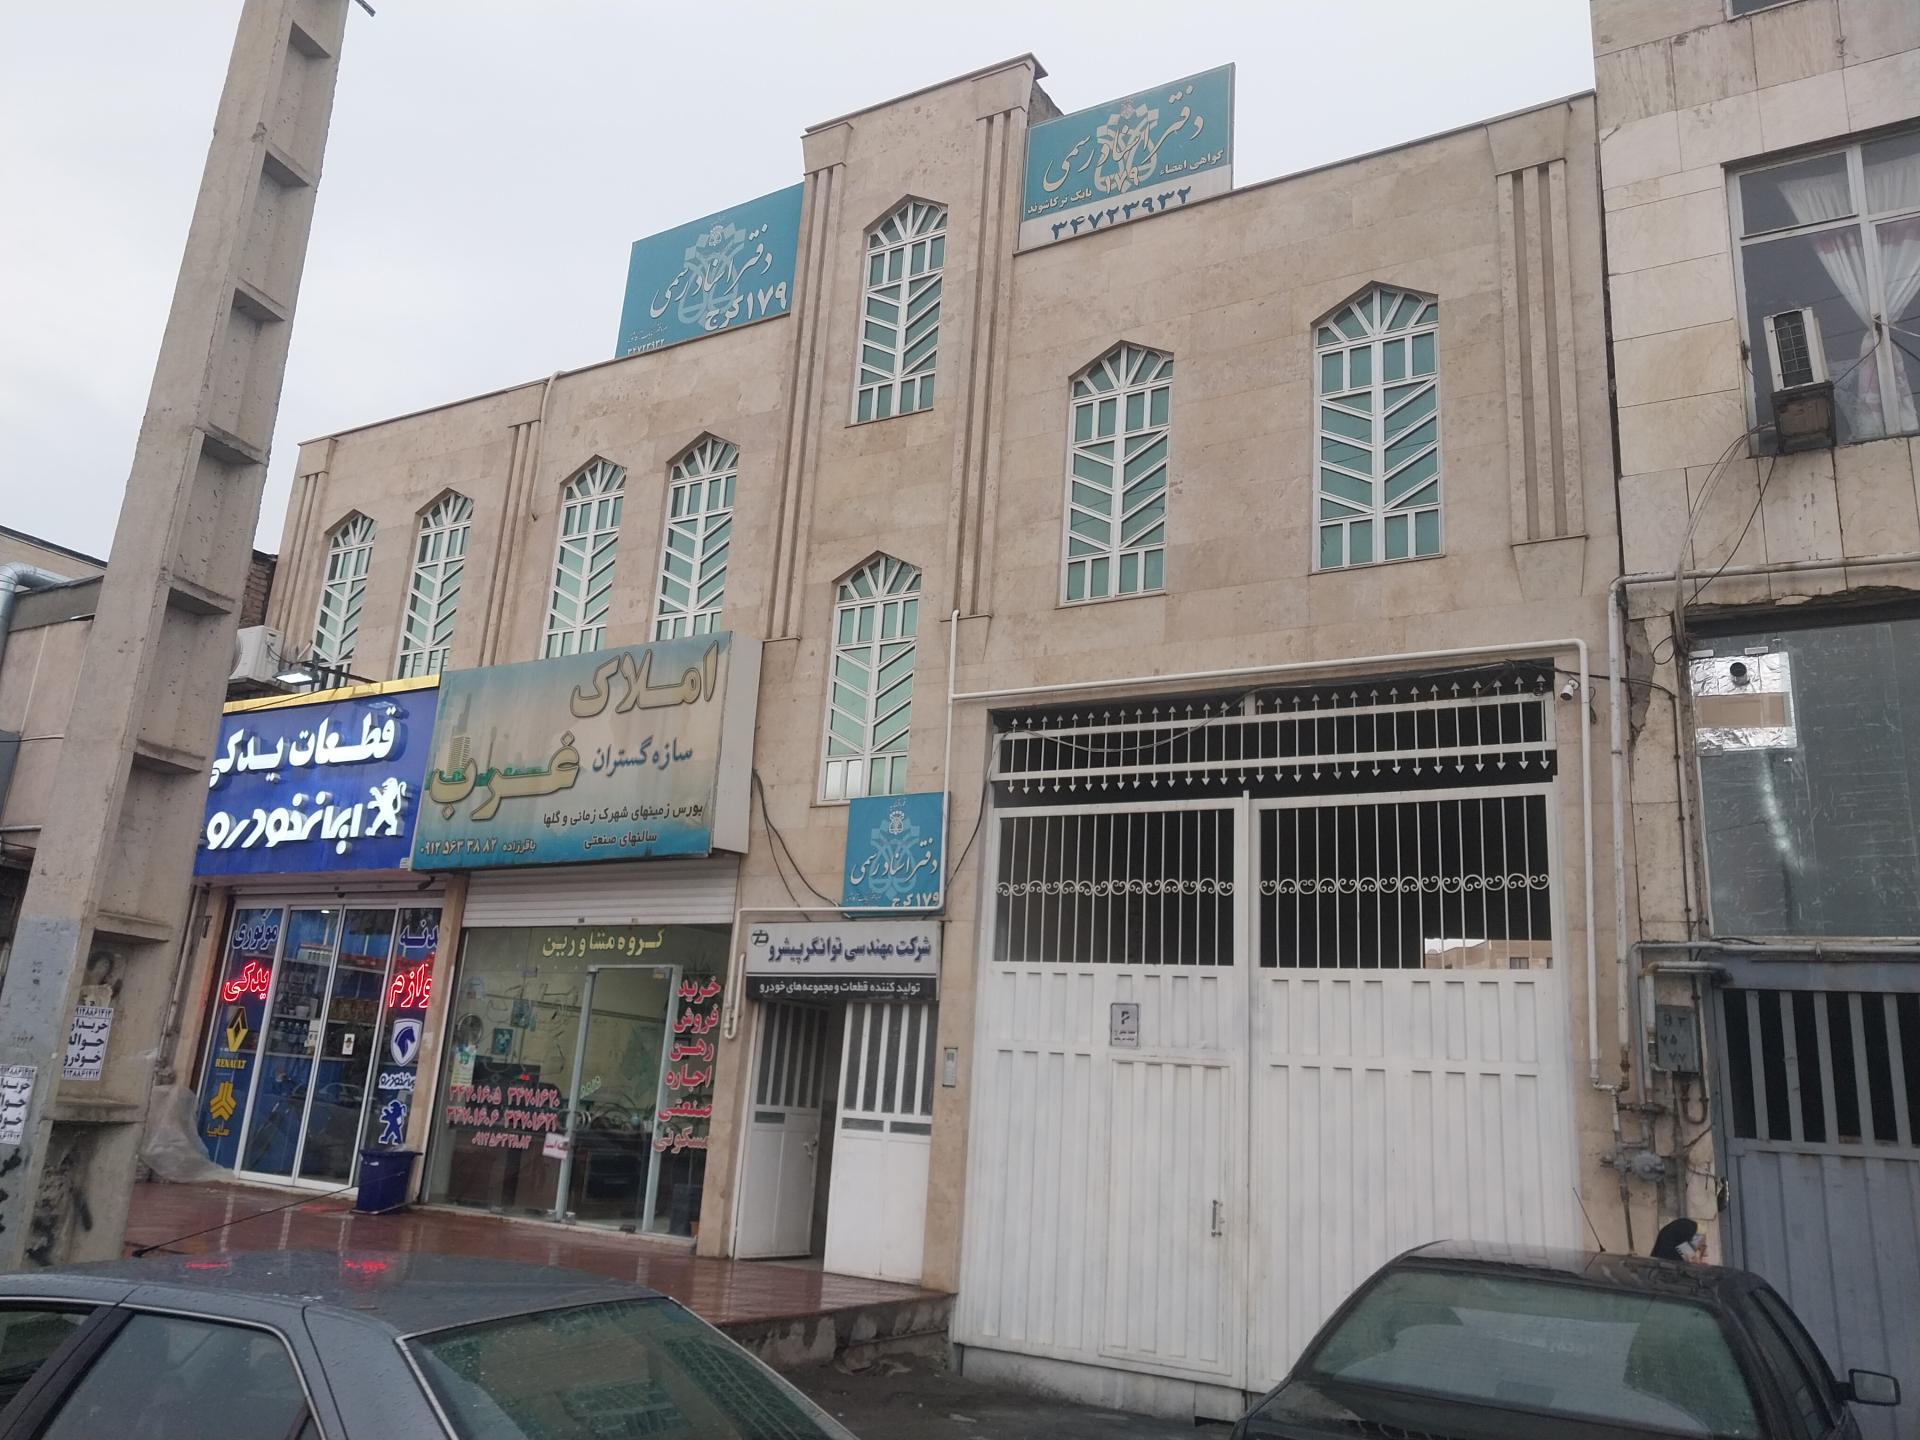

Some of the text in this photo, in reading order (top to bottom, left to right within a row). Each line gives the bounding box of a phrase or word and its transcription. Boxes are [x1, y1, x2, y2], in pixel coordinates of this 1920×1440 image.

[1042, 85, 1204, 192] دفتر اسناد رسمی
[1105, 166, 1139, 195] ۱۷۹
[1051, 186, 1191, 240] ۳۴۷۲۳۹۳۲
[650, 223, 773, 319] دفتر اسناد رسمی
[704, 281, 787, 331] ۱۷۹ کرج
[570, 640, 719, 718] املاک
[209, 705, 396, 788] قطعات یدکی
[592, 734, 693, 778] سازه گستران
[429, 730, 581, 820] غرب
[561, 814, 568, 827] و
[570, 810, 597, 825] زمانی
[598, 806, 628, 823] شهرک
[584, 830, 657, 850] سالنهای صنعتی
[850, 838, 938, 885] دفتر اسناد رسمی
[399, 919, 438, 950] دنه
[542, 930, 615, 957] مشاورین
[768, 935, 932, 965] شرکت مهندسی توانگر پیشرو
[222, 962, 270, 1002] یدکی
[389, 963, 433, 1008] وازم
[677, 975, 721, 1003] خرید
[759, 980, 785, 994] خودرو
[840, 981, 868, 992] قطعات
[870, 981, 895, 993] کننده
[896, 982, 921, 995] تولید
[71, 1018, 108, 1034] خریدار
[673, 1004, 719, 1034] فروش
[63, 1051, 101, 1068] خودرو
[669, 1038, 714, 1061] رهن
[215, 1058, 247, 1070] RENAULT
[665, 1064, 712, 1092] اجاره
[658, 1099, 713, 1121] صنعتی
